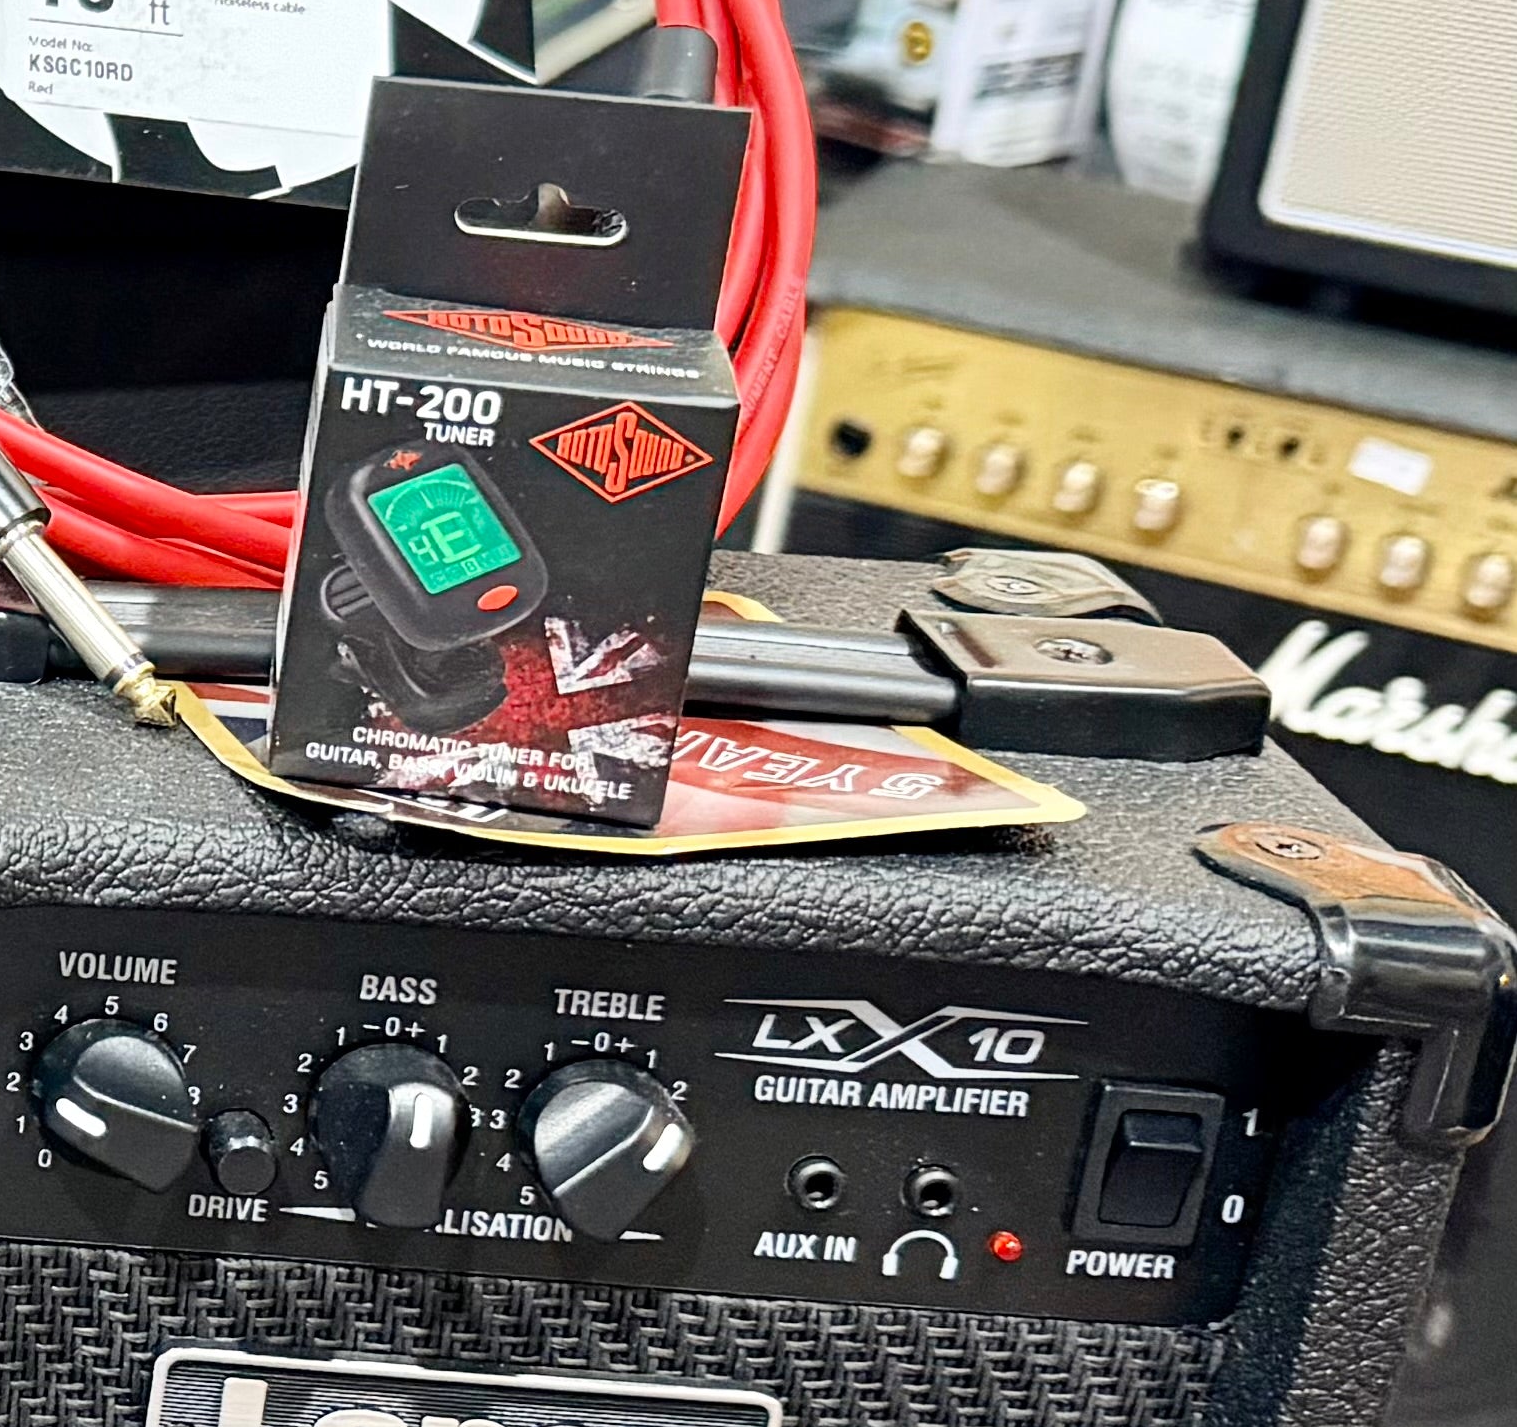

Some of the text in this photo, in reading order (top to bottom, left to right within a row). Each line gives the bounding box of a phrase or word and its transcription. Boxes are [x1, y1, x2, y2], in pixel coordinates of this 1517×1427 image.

[273, 1, 306, 15] cable
[27, 34, 68, 51] Model
[28, 53, 135, 83] KSGC10RD
[27, 79, 54, 96] Red
[367, 337, 442, 354] WORLD
[446, 344, 534, 363] FAMOUS
[538, 353, 607, 370] MUSIC
[340, 376, 503, 426] HT-200
[424, 421, 496, 448] TUNER
[1254, 619, 1517, 785] Marsh
[351, 725, 592, 774] CHROMATIC TUNER FOR
[304, 741, 382, 771] GUITAR,
[452, 762, 520, 788] VIOLIN
[522, 771, 542, 788] &
[542, 775, 635, 801] UKULELE
[59, 950, 178, 986] VOLUME
[359, 974, 438, 1006] BASS
[54, 1004, 69, 1025] 4
[104, 995, 120, 1017] 5
[554, 987, 666, 1023] TREBLE
[153, 1012, 168, 1033] 6
[18, 1030, 35, 1052] 3
[336, 1026, 348, 1047] 1
[436, 1033, 449, 1054] 1
[182, 1042, 198, 1065] 7
[543, 1041, 557, 1062] 1
[646, 1047, 659, 1069] 1
[296, 1052, 313, 1074] 2
[5, 1072, 21, 1093] 2
[461, 1065, 481, 1087] 2
[504, 1068, 523, 1089] 2
[671, 1080, 689, 1102] 2
[753, 1075, 1029, 1118] GUITAR AMPLIFIER
[283, 1093, 299, 1115] 3
[15, 1115, 27, 1134] 1
[488, 1108, 508, 1130] 3
[288, 1135, 305, 1157] 4
[37, 1148, 53, 1169] 0
[495, 1152, 512, 1172] 4
[313, 1170, 329, 1191] 5
[519, 1185, 536, 1207] 5
[186, 1193, 574, 1244] DRIVE LISATION
[1221, 1195, 1244, 1224] 0
[753, 1231, 857, 1264] AUX IN
[1066, 1249, 1176, 1280] POWER
